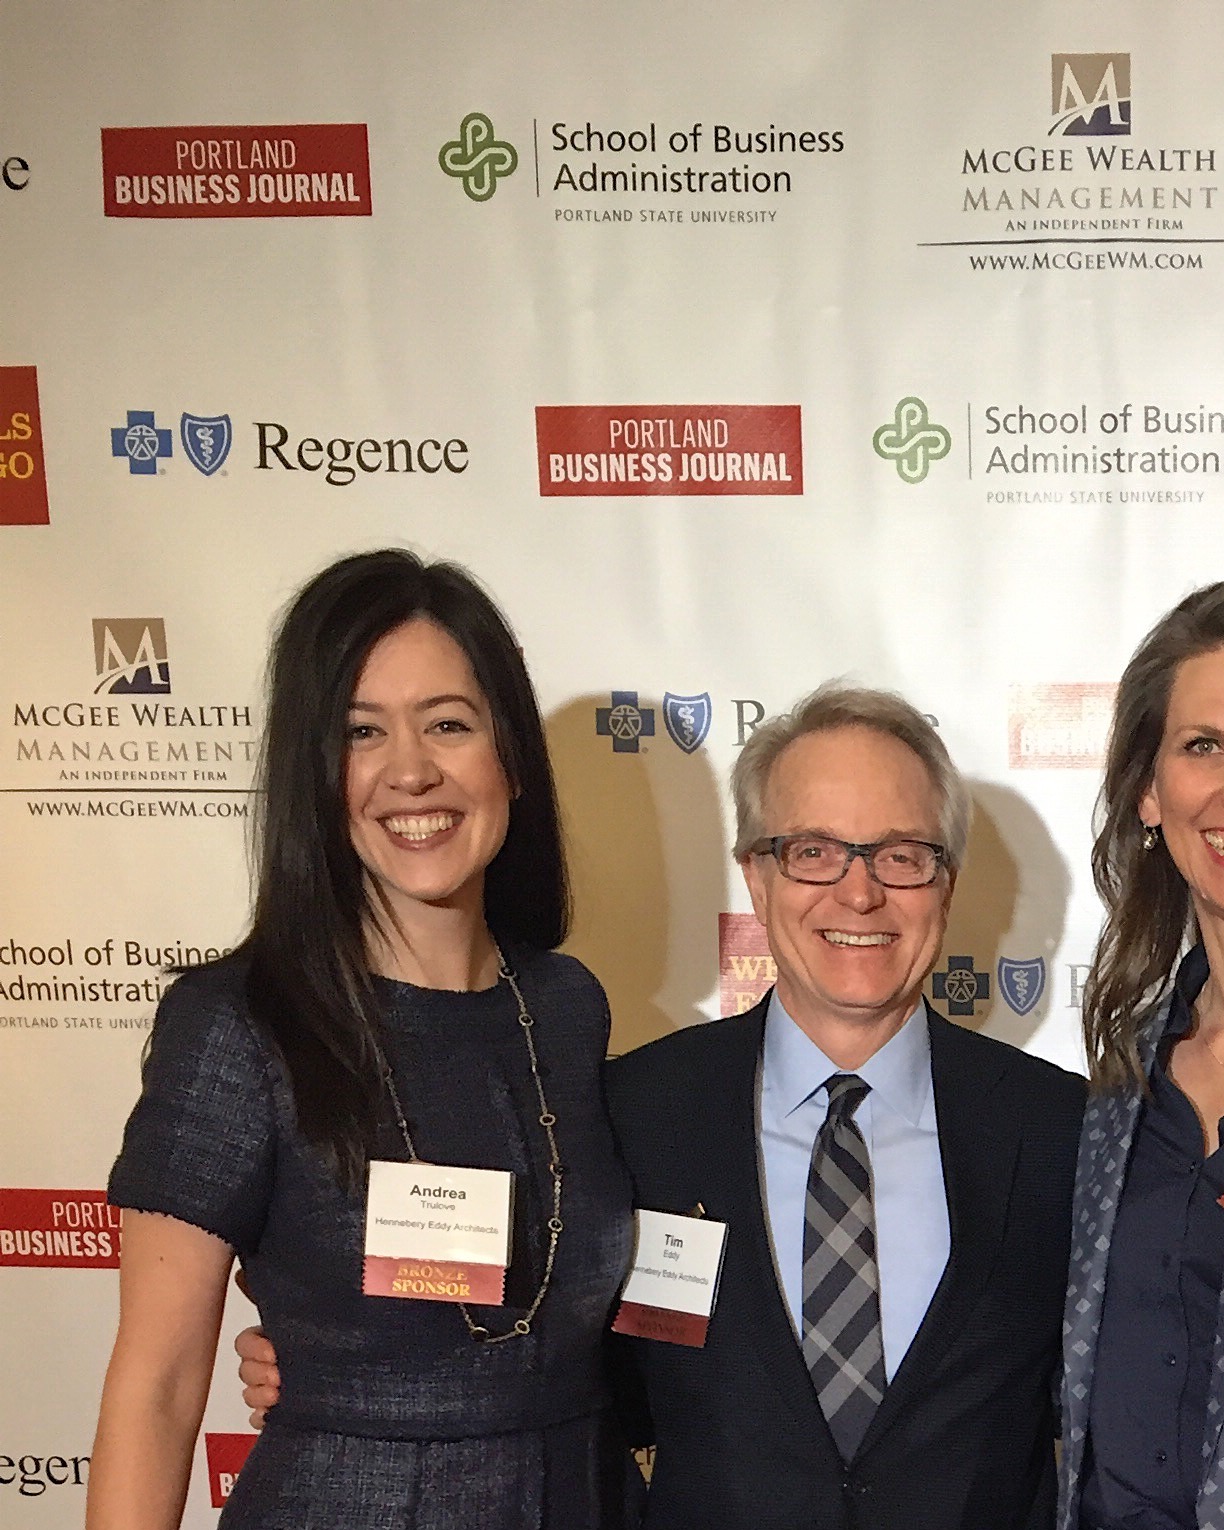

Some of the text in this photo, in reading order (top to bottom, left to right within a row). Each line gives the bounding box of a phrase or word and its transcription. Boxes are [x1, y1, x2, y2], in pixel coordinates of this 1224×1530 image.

[552, 122, 843, 153] School of Business
[176, 140, 295, 170] PORTLAND
[1087, 146, 1216, 171] WEALTH
[116, 173, 360, 204] BUSINESS JOURNAL
[554, 163, 791, 192] Administration
[962, 187, 1217, 212] MANAGEMENT
[555, 209, 776, 223] PORTLAND STATE UNIVERSITY
[1005, 218, 1182, 231] AN INDEPENDENT FIRM
[986, 405, 1086, 434] School
[1100, 404, 1132, 434] of
[610, 419, 728, 448] PORTLAND
[253, 423, 468, 486] Regence
[986, 444, 1219, 474] Administration
[550, 453, 791, 482] BUSINESS JOURNAL
[987, 490, 1204, 504] PORTLAND STATE UNIVERSITY
[132, 704, 252, 726] WEALTH
[16, 740, 254, 763] MANAGEMENT
[60, 770, 227, 780] AN INDEPENDENT FIRM
[0, 939, 230, 967] chool of Busine
[0, 976, 167, 1002] dministrati
[0, 1017, 153, 1029] ORTLAND STATE UNIVE
[410, 1186, 466, 1200] Andrea
[53, 1202, 118, 1228] PORTL
[0, 1230, 112, 1257] BUSINESS
[664, 1234, 683, 1249] Tim
[663, 1250, 679, 1260] Eddy
[392, 1280, 470, 1296] SPONSOR
